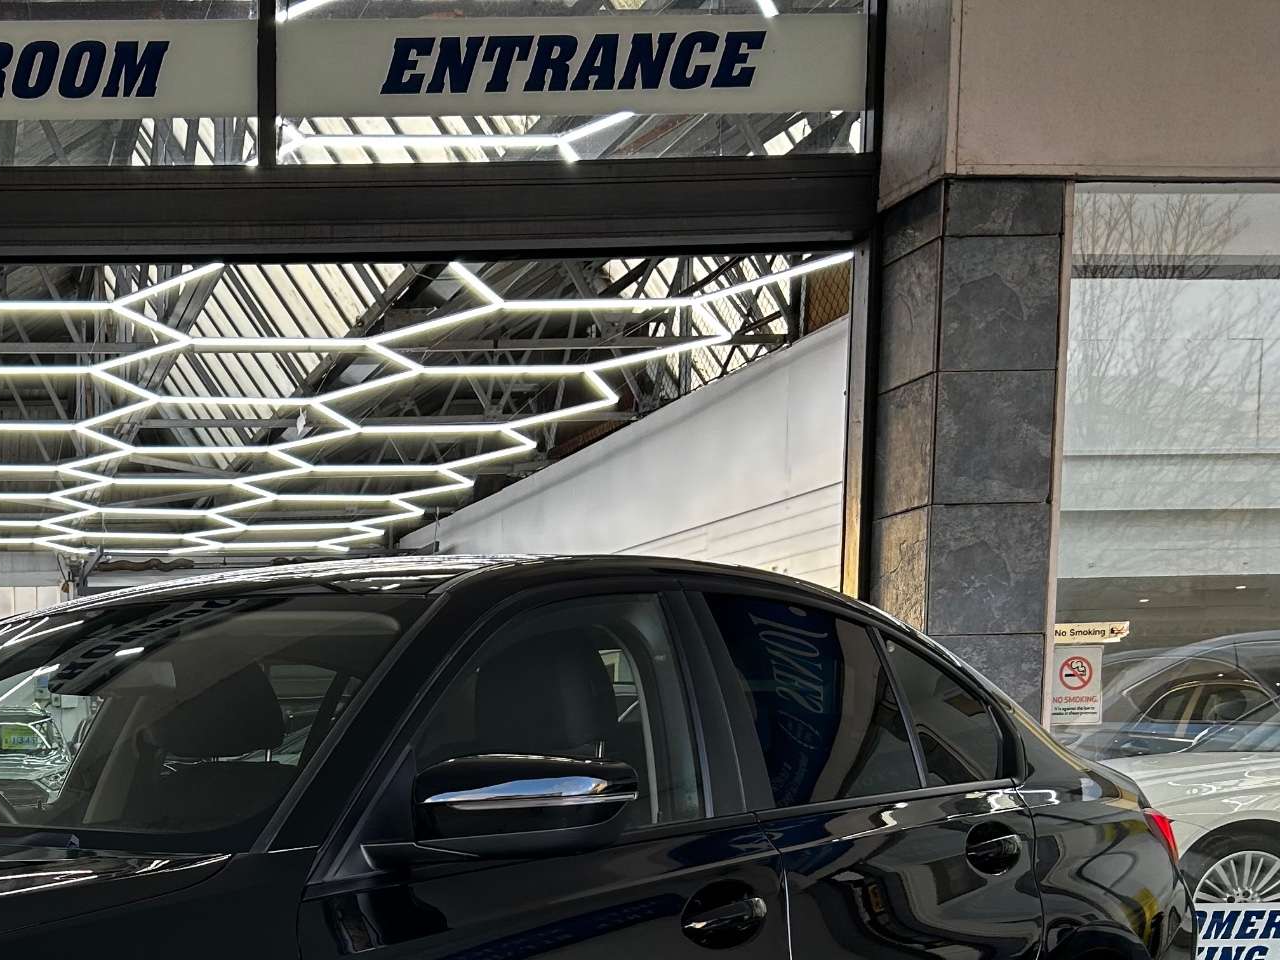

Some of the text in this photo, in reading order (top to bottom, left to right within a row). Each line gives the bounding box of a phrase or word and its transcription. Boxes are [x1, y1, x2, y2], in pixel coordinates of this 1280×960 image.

[380, 30, 767, 95] ENTRANCE
[1055, 628, 1106, 638] No Smoking
[1053, 696, 1064, 704] NO
